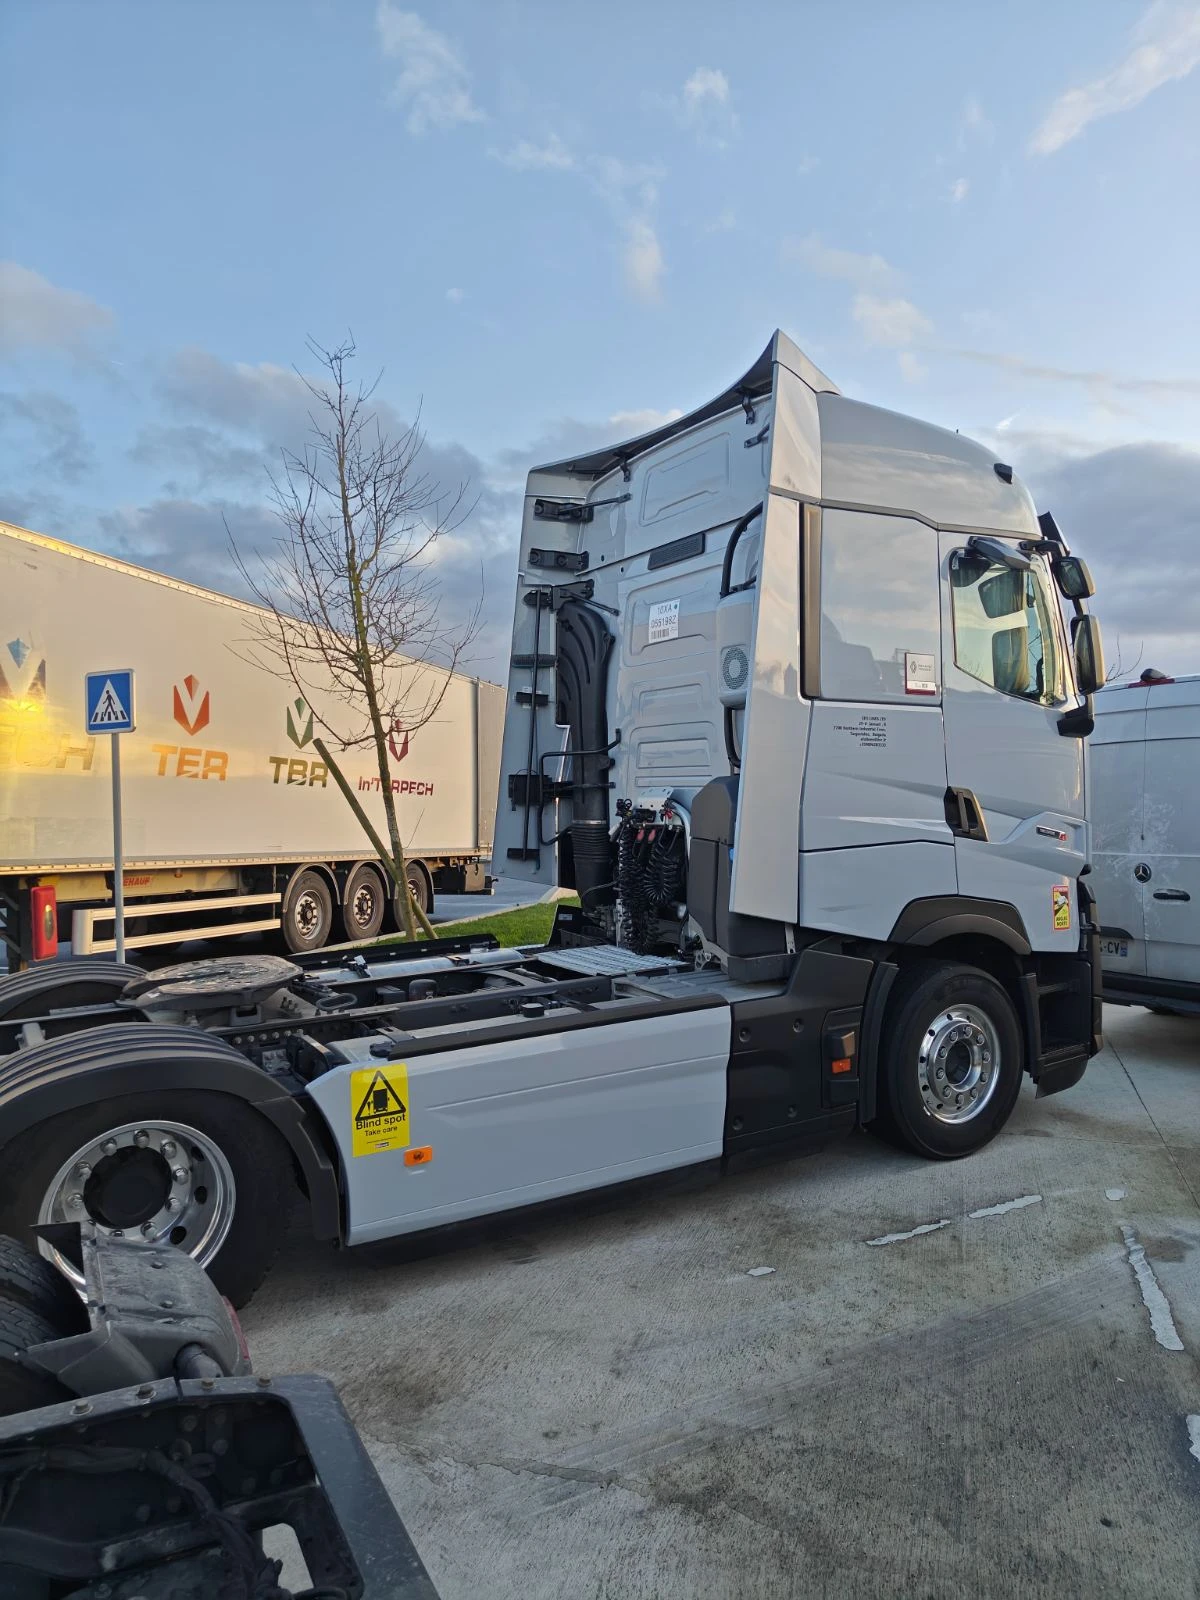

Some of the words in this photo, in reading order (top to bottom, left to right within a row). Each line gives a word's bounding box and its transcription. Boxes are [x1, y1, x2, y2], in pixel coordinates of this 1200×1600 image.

[152, 743, 229, 781] TER
[269, 756, 328, 788] TBR
[358, 776, 434, 796] In'TRPECH
[123, 875, 152, 887] EHAUF
[1100, 940, 1120, 954] -CV
[356, 1117, 381, 1130] Blind
[384, 1113, 406, 1126] spot
[364, 1128, 381, 1137] Take
[382, 1126, 398, 1134] care
